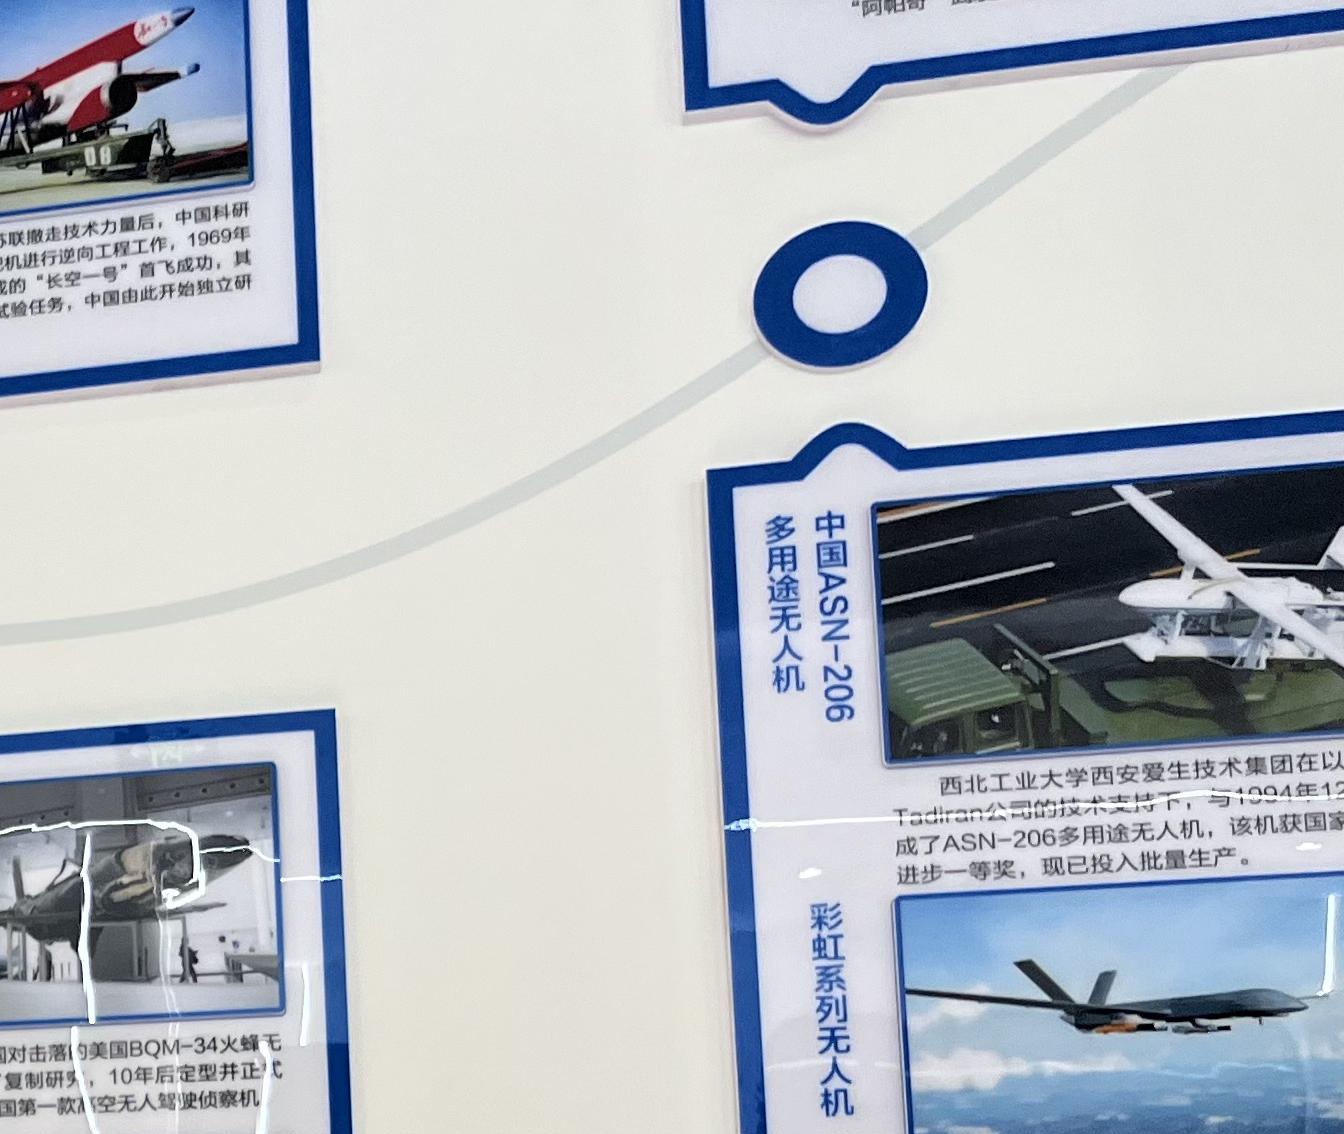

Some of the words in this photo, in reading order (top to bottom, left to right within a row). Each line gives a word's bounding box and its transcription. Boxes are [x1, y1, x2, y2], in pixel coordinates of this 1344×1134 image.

[765, 515, 805, 693] 多用途无人机
[815, 510, 855, 722] 中国ASN-206
[939, 751, 1344, 797] 西北工业大学西安爱生技术集团在以
[896, 846, 1251, 886] 进步一等奖，现已投入批量生产。
[809, 902, 855, 1118] 彩虹系列无人机
